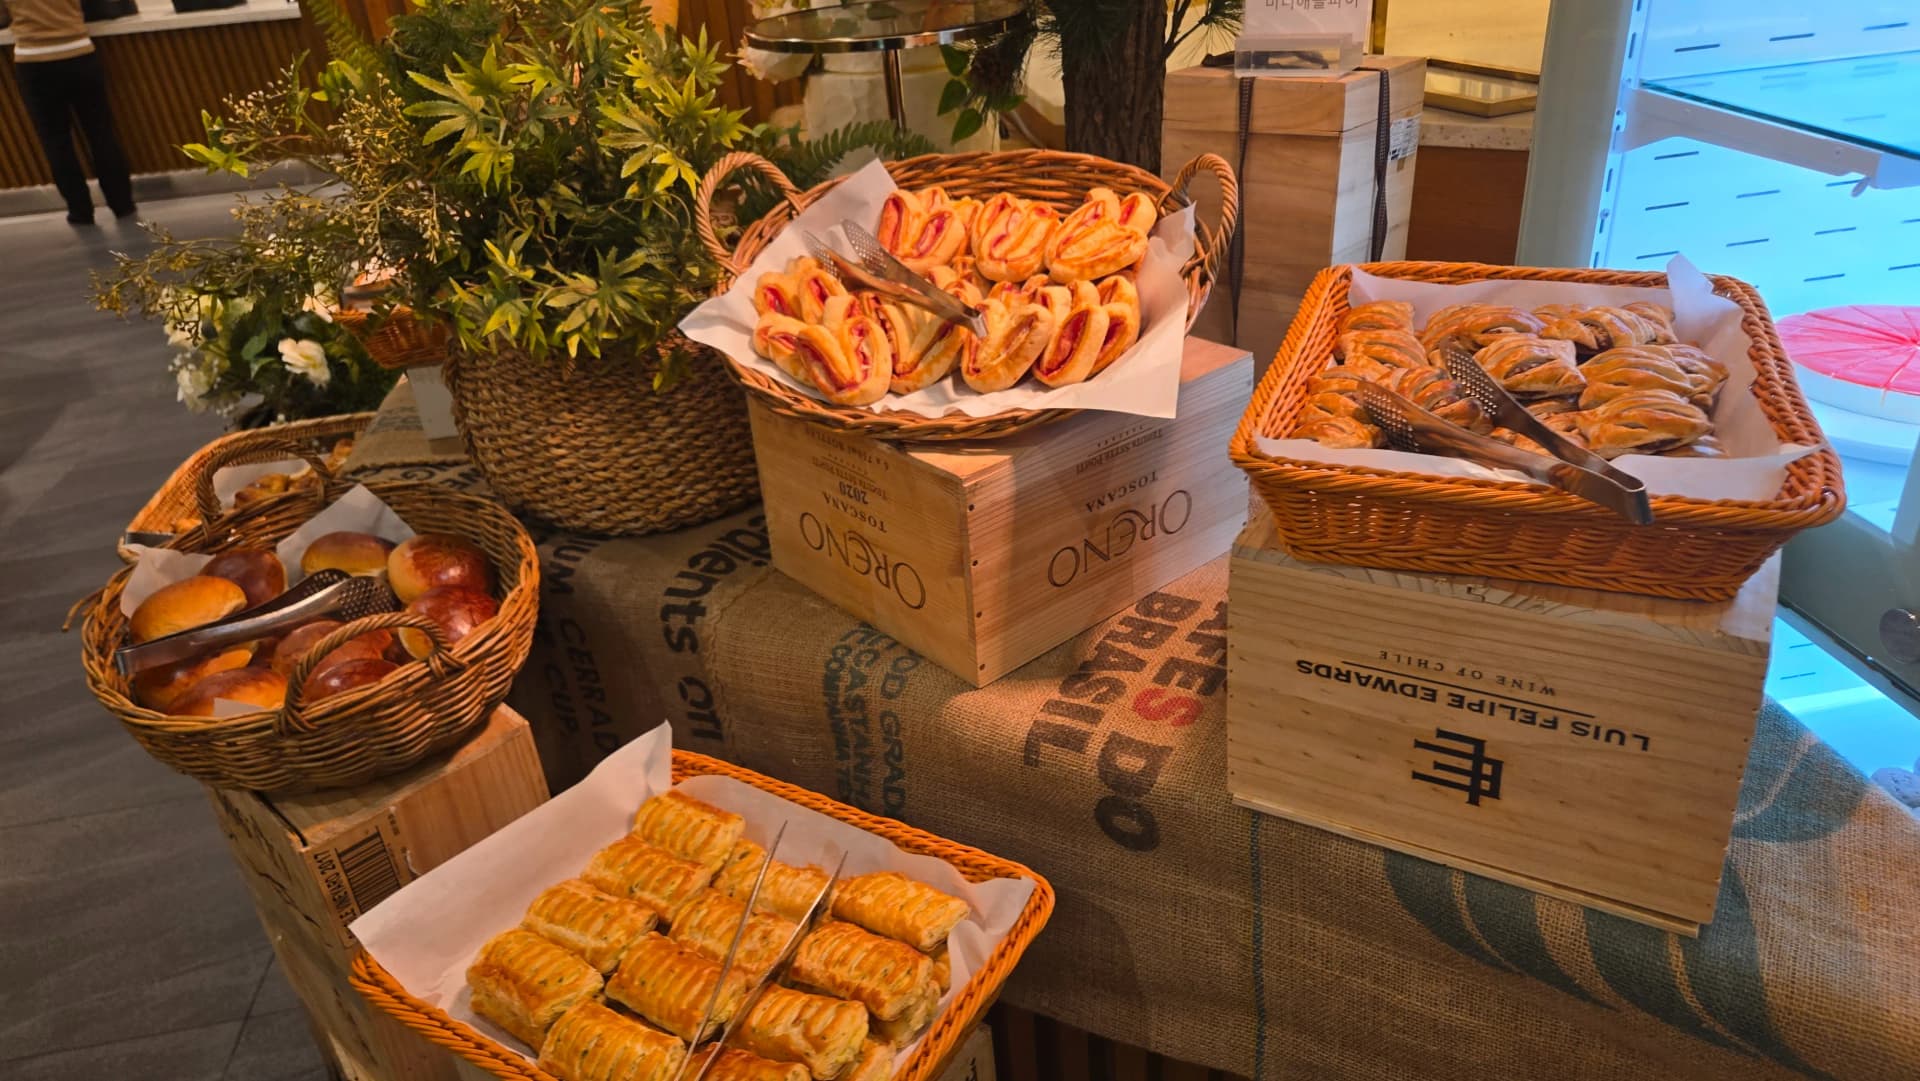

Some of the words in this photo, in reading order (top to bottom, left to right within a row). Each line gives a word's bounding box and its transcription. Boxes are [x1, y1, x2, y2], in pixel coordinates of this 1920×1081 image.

[821, 490, 888, 534] TOSCANA
[838, 480, 869, 505] 2020
[1085, 470, 1159, 513] TOSCANA
[1047, 489, 1193, 588] ORENO
[799, 511, 927, 610] ORENO
[1023, 591, 1202, 769] BRASIL
[1295, 658, 1438, 704] EDWARDS
[1378, 650, 1445, 672] CHILE
[1455, 667, 1484, 682] OF
[1495, 673, 1556, 697] WINE
[1446, 691, 1559, 731] FELIPE
[1570, 719, 1651, 752] LUIS
[1093, 730, 1174, 852] DO
[313, 848, 337, 875] 2017
